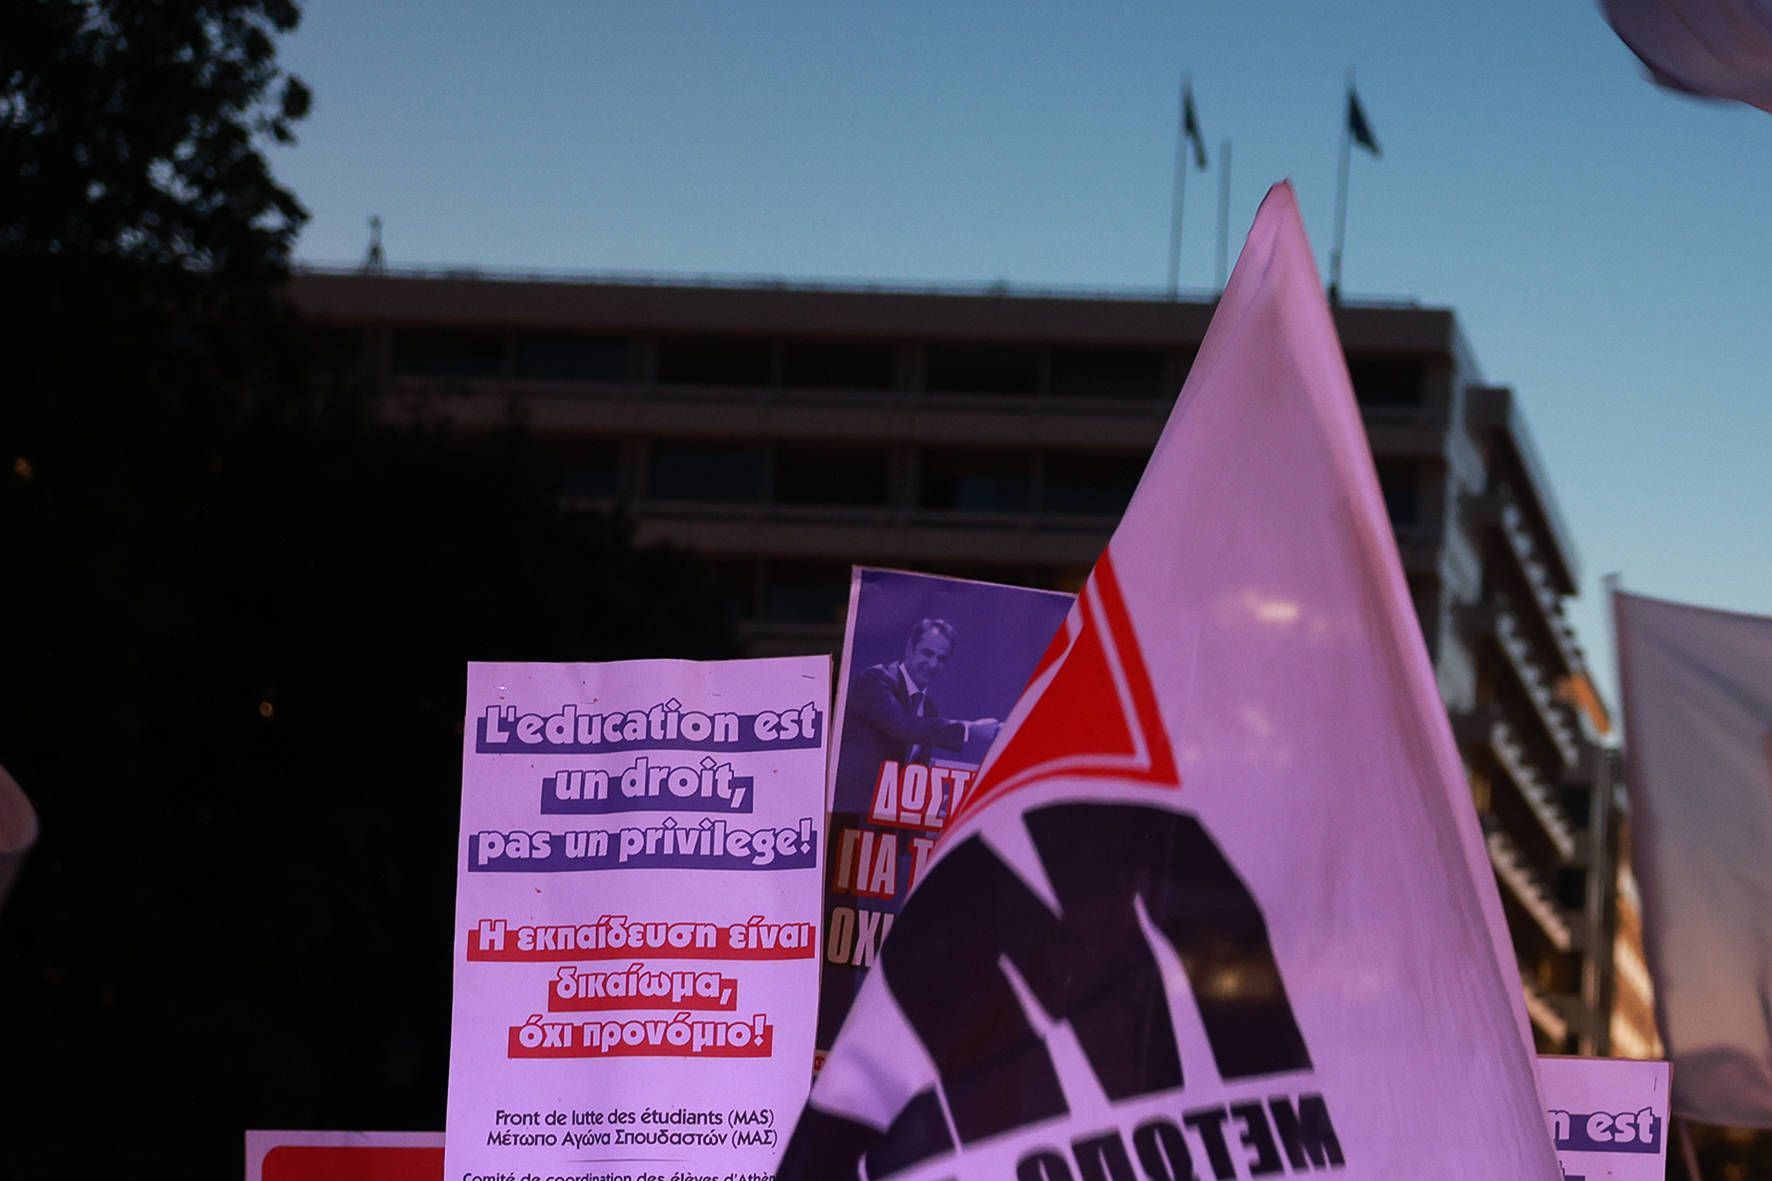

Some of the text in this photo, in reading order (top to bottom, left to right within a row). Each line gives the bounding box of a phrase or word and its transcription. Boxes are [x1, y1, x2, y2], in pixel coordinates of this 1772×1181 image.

[483, 697, 817, 744] L'education est
[555, 756, 746, 809] un droit,
[873, 760, 977, 827] ΔΩΣΤ
[476, 817, 813, 867] pas un privilege!
[837, 829, 896, 895] ΓΙΑ
[478, 914, 811, 951] Η εκπαίδευση είναι
[556, 963, 731, 1005] δικαίωμα,
[518, 1011, 767, 1052] όχι προνόμιο!
[495, 1107, 774, 1128] Front de lutte des étudiants (MAS)
[1586, 1106, 1655, 1145] est
[486, 1128, 778, 1150] Μέτωπο Αγώνα Σπουδαστών (ΜΑΣ)
